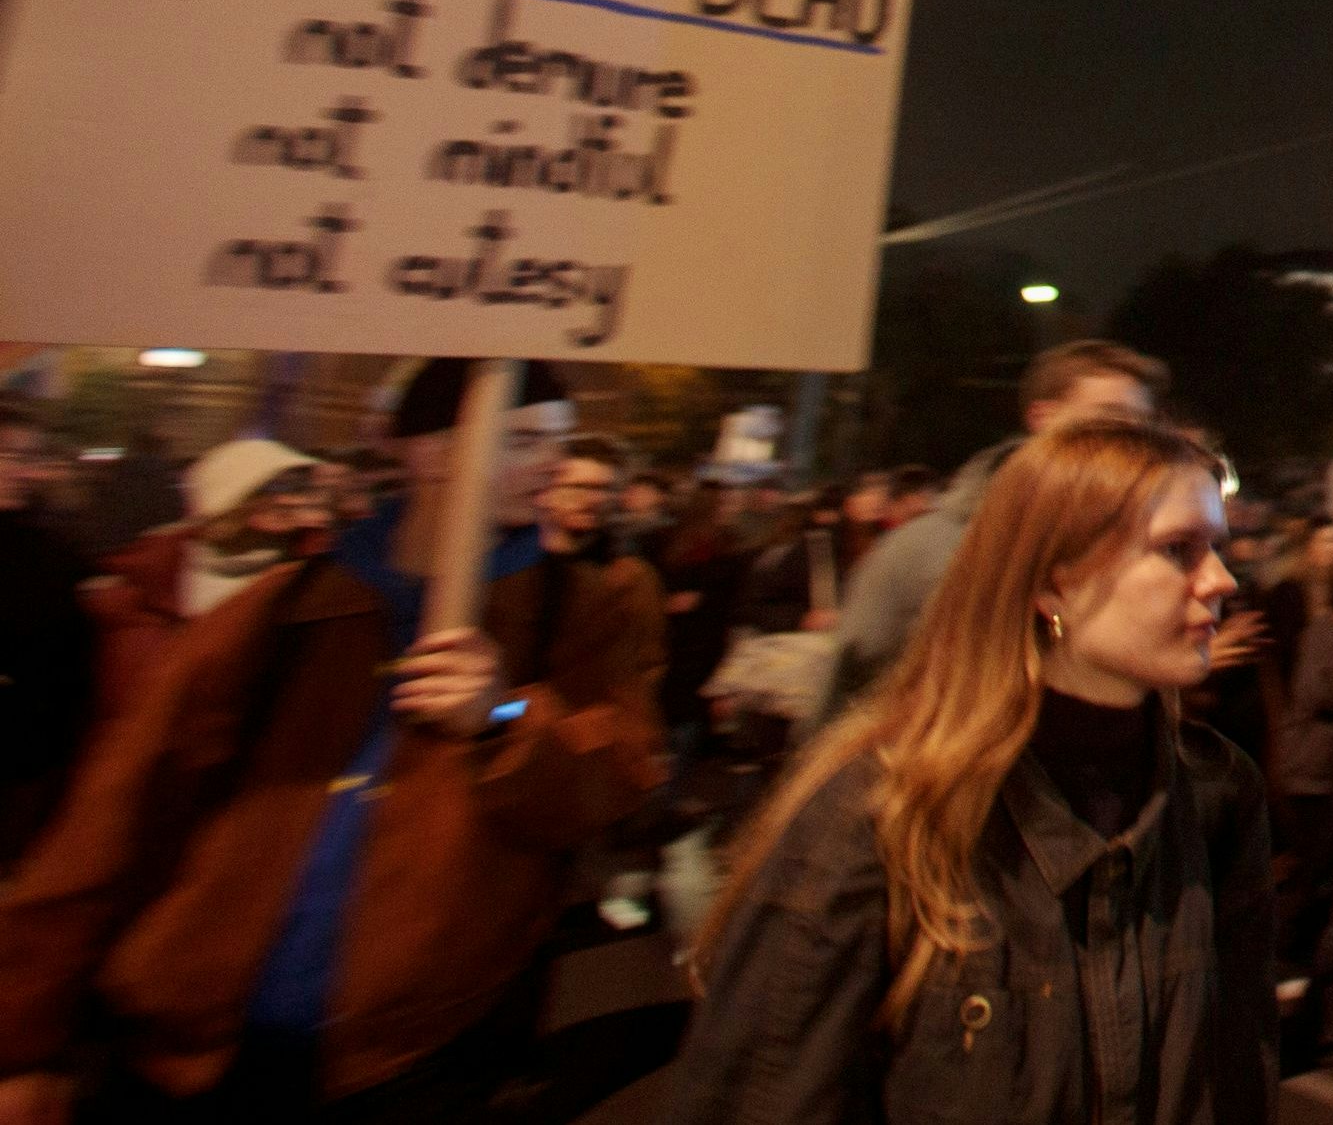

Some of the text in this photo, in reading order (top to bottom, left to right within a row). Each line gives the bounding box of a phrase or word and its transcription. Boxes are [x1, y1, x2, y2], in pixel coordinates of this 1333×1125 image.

[231, 94, 678, 206] not mindful
[205, 202, 634, 348] not cutesy
